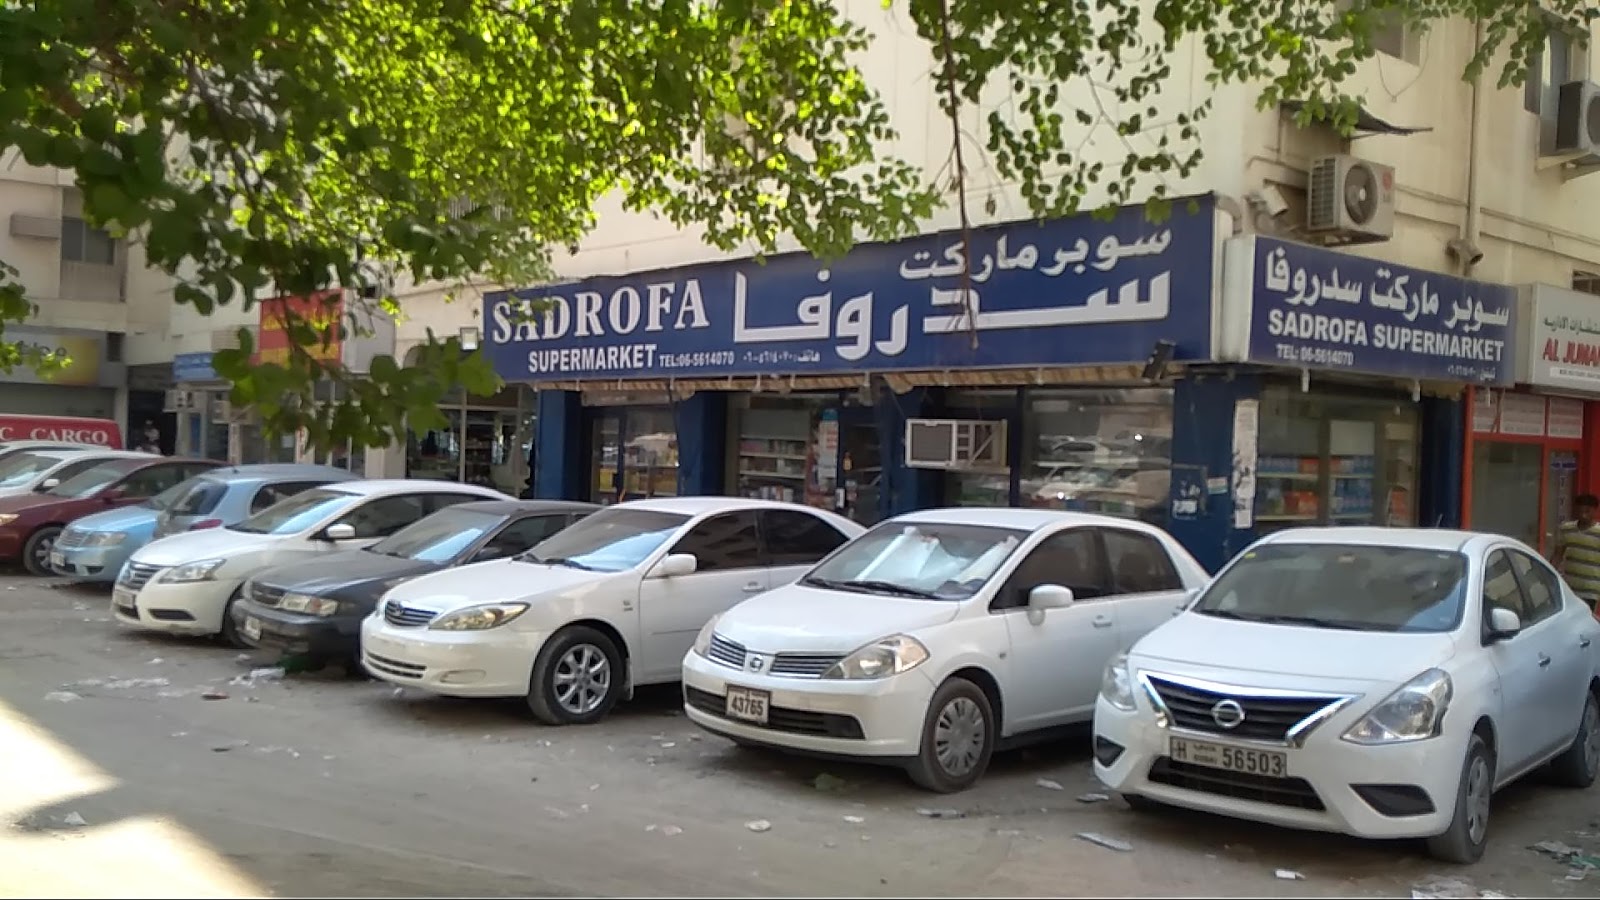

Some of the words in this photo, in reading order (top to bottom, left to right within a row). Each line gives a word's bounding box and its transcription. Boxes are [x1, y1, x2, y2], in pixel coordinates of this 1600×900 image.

[899, 234, 1039, 282] ماركت
[1039, 228, 1172, 277] سوبر
[1266, 246, 1363, 306] سدروفا
[493, 278, 710, 344] SADROFA
[734, 269, 1171, 361] سدروفا
[1370, 266, 1439, 321] ماركت
[1443, 296, 1509, 333] سوبر
[528, 343, 658, 374] SUPERMARKET
[1268, 308, 1368, 346] SADROFA
[1373, 323, 1504, 361] SUPERMARKET
[30, 427, 108, 445] CARGO
[731, 695, 764, 716] 43765
[1222, 747, 1283, 776] 56503
